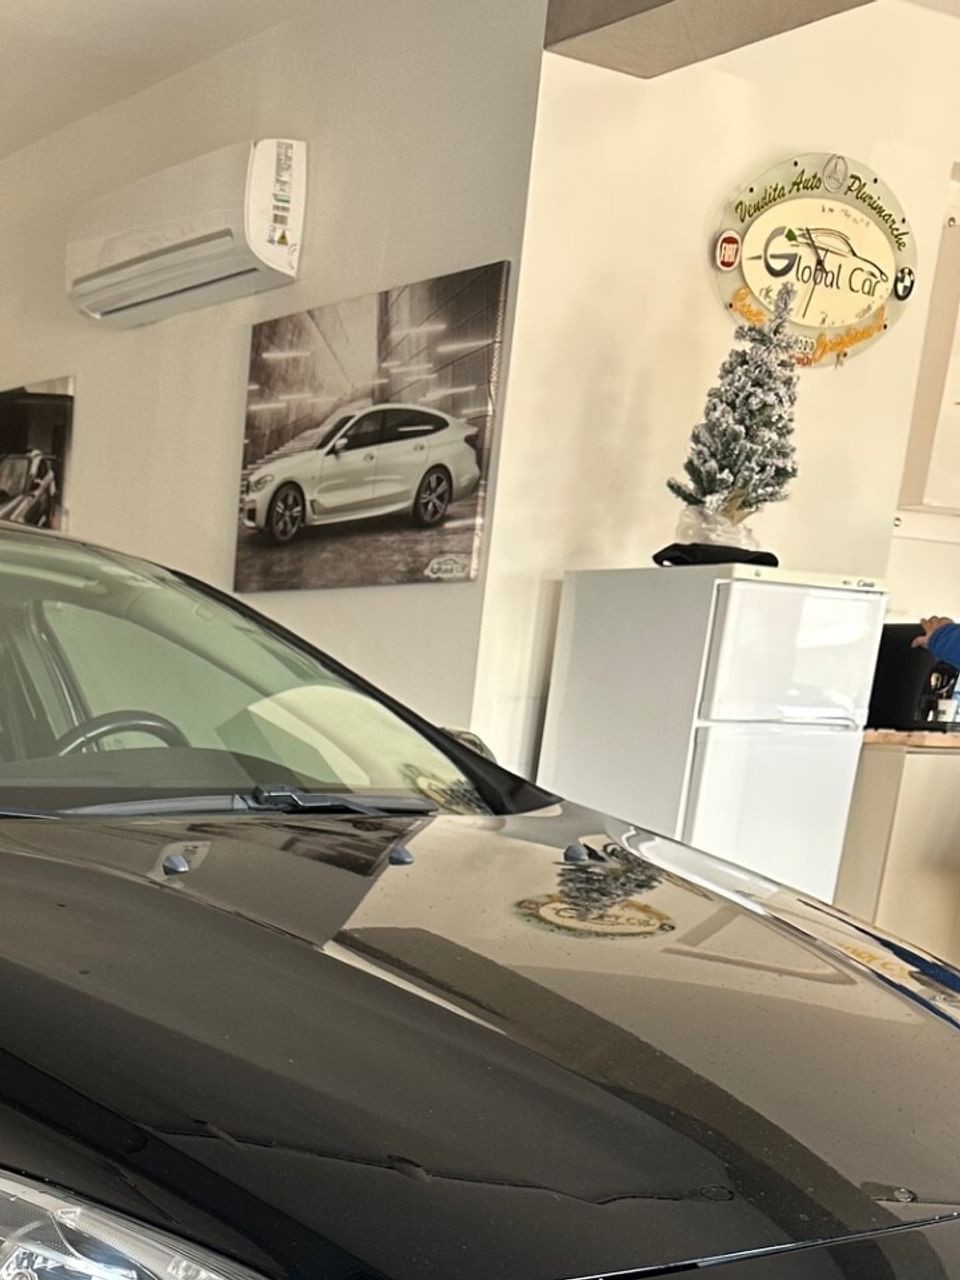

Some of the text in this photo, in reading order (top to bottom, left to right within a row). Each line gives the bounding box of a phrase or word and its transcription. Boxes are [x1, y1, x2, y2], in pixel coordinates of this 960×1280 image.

[735, 183, 785, 222] Vendita
[788, 169, 822, 194] Auto
[844, 174, 909, 251] Plurimarche
[763, 226, 842, 289] Global
[849, 267, 881, 297] Car
